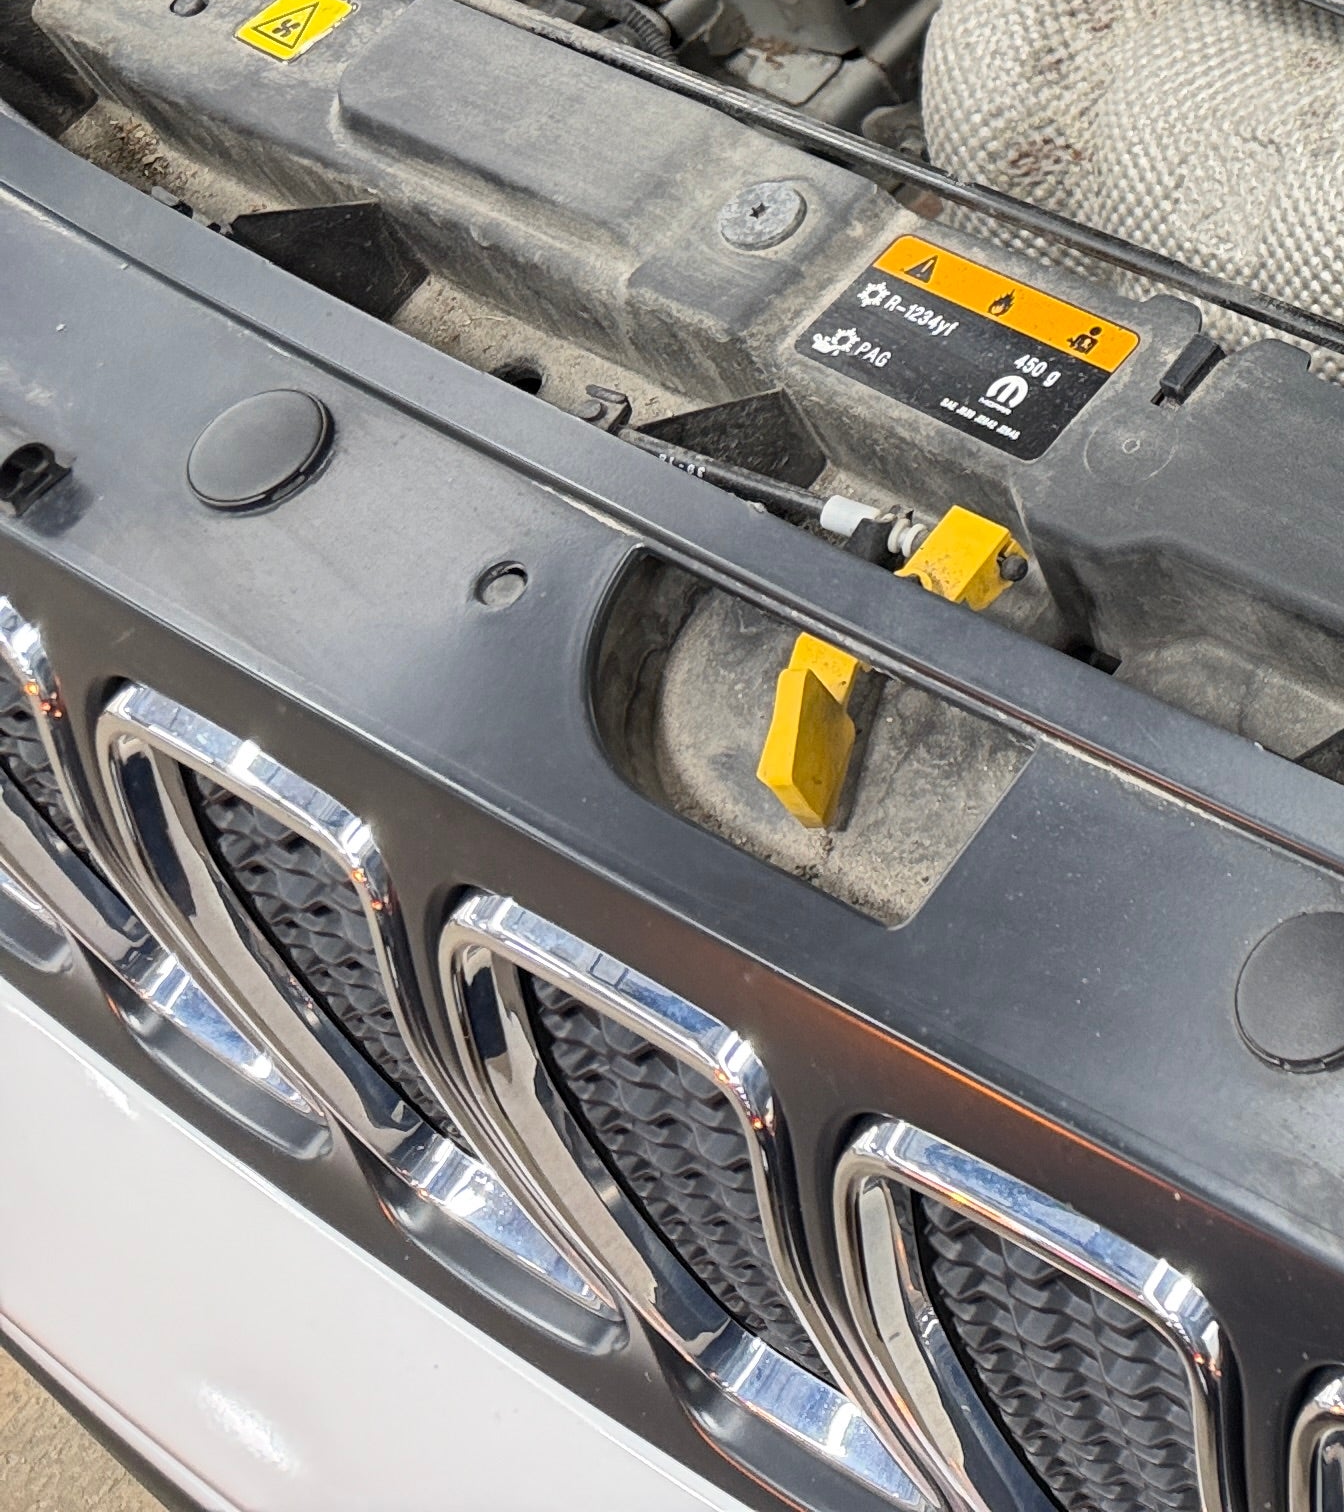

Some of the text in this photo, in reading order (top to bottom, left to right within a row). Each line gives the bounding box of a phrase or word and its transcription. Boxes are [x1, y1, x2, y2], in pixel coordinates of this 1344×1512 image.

[883, 291, 960, 337] R-1234yf
[853, 338, 892, 368] PAG
[1013, 354, 1062, 388] 450 g
